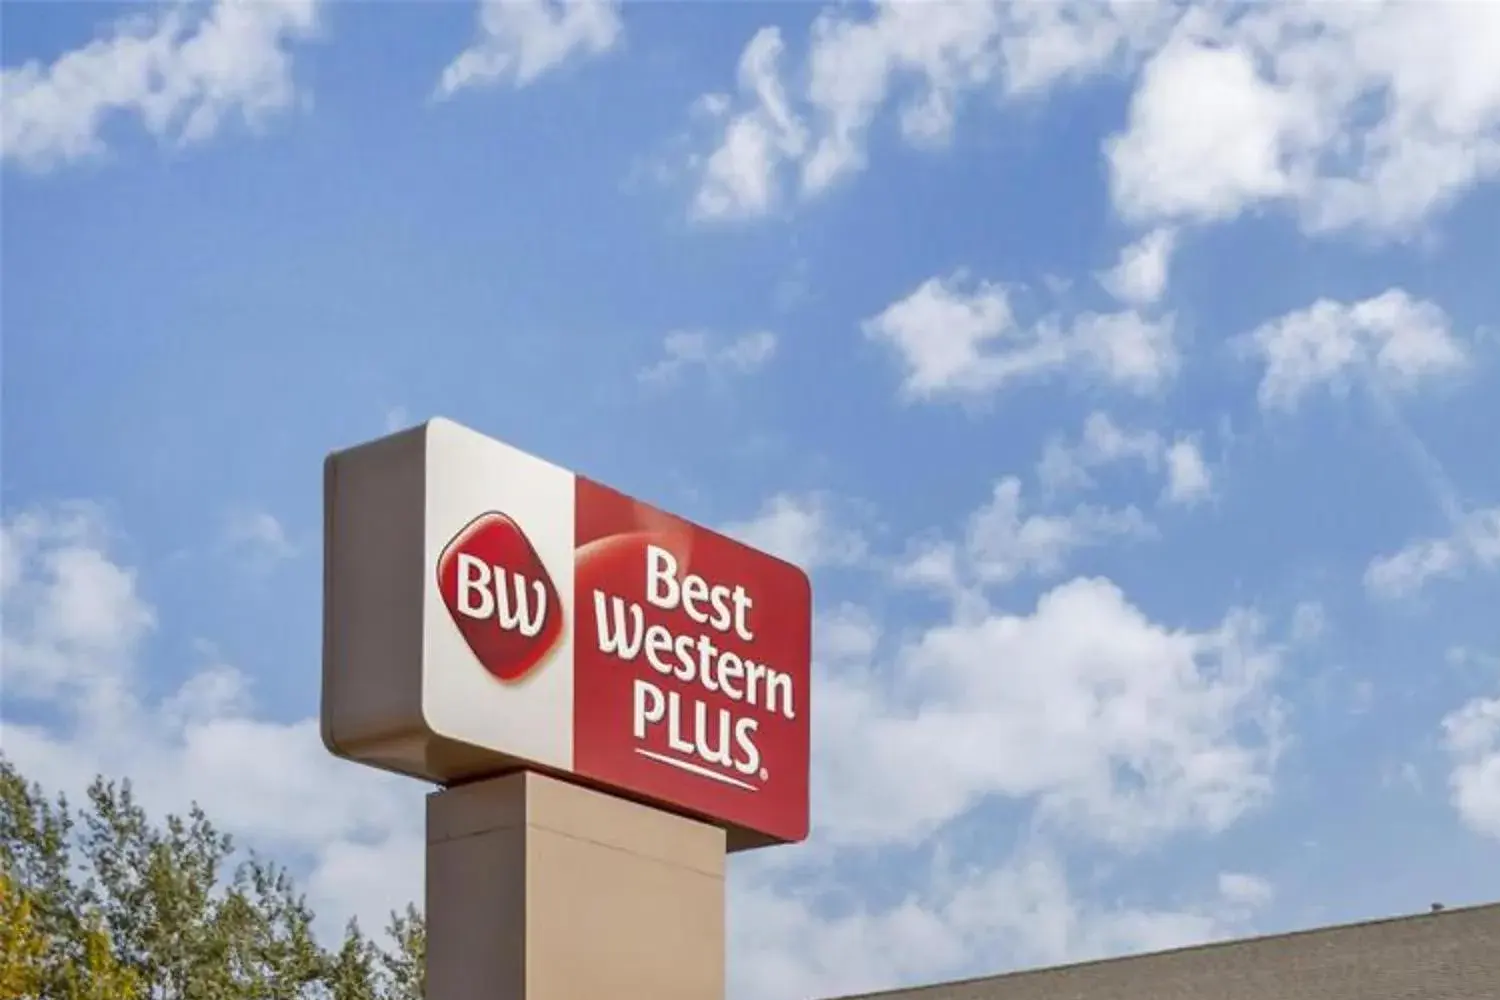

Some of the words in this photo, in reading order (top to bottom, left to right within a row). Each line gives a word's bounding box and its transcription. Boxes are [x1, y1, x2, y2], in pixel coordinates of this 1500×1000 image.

[457, 552, 547, 637] BW
[646, 545, 754, 641] Best
[593, 590, 796, 719] Western
